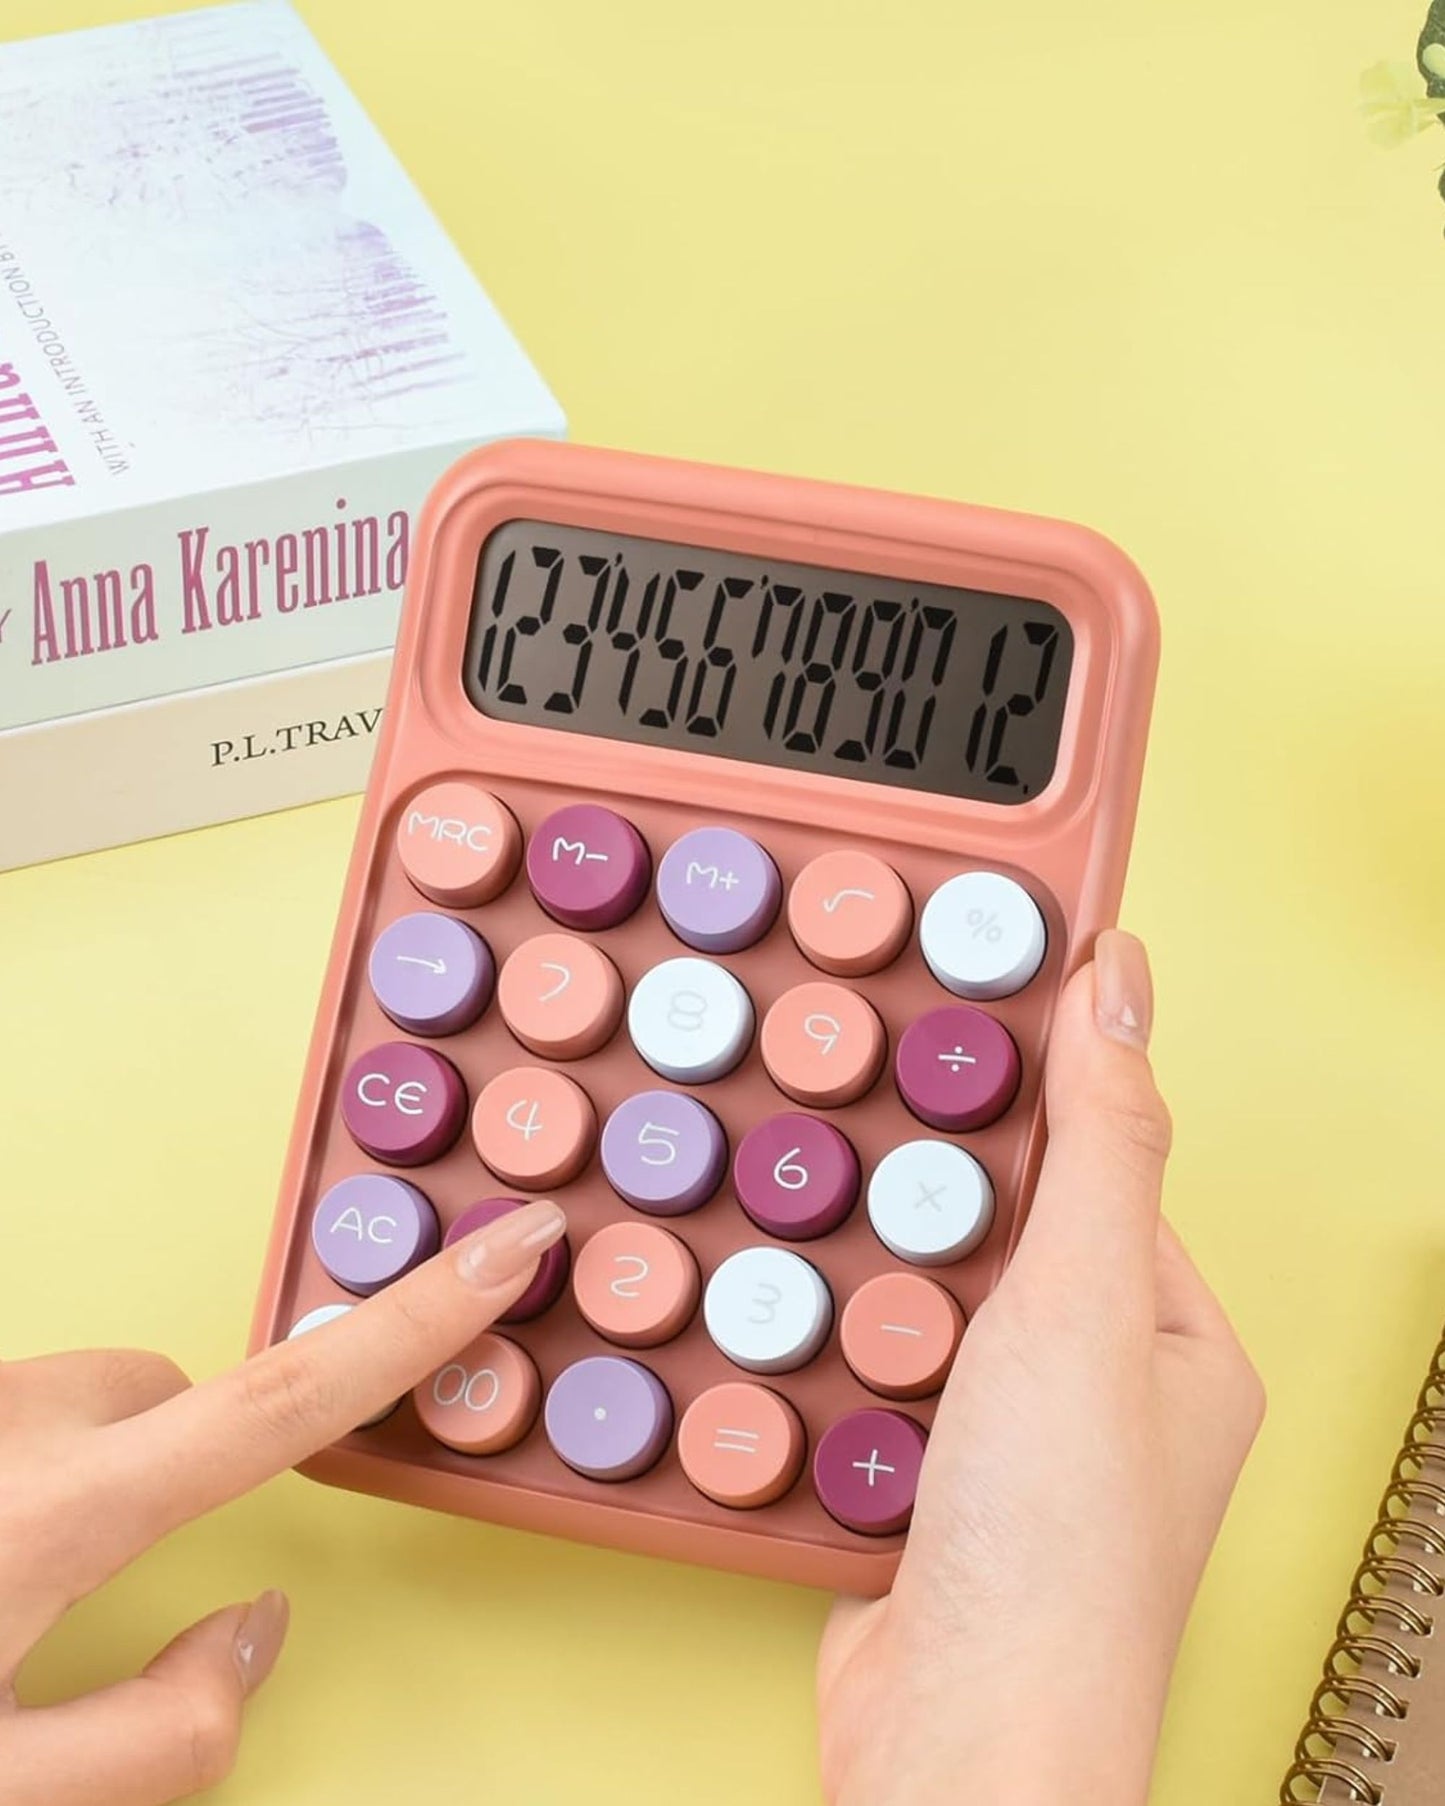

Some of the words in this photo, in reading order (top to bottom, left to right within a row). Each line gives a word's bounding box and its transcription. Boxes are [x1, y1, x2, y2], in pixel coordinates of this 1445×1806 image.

[1, 265, 87, 396] INTRODUCTION
[73, 400, 104, 423] AN
[89, 428, 130, 475] WITH
[31, 559, 159, 666] Anna
[177, 498, 410, 635] Karenina
[407, 811, 492, 852] MRC
[685, 861, 739, 892] M+
[965, 907, 1003, 944] %
[538, 961, 571, 1003] 7
[666, 989, 708, 1033] 8
[803, 1013, 841, 1056] 9
[357, 1072, 428, 1116] CE
[506, 1099, 544, 1142] 4
[638, 1121, 680, 1166] 5
[773, 1147, 809, 1191] 6
[329, 1206, 397, 1244] AC
[609, 1254, 649, 1298] 2
[746, 1282, 783, 1325] 3
